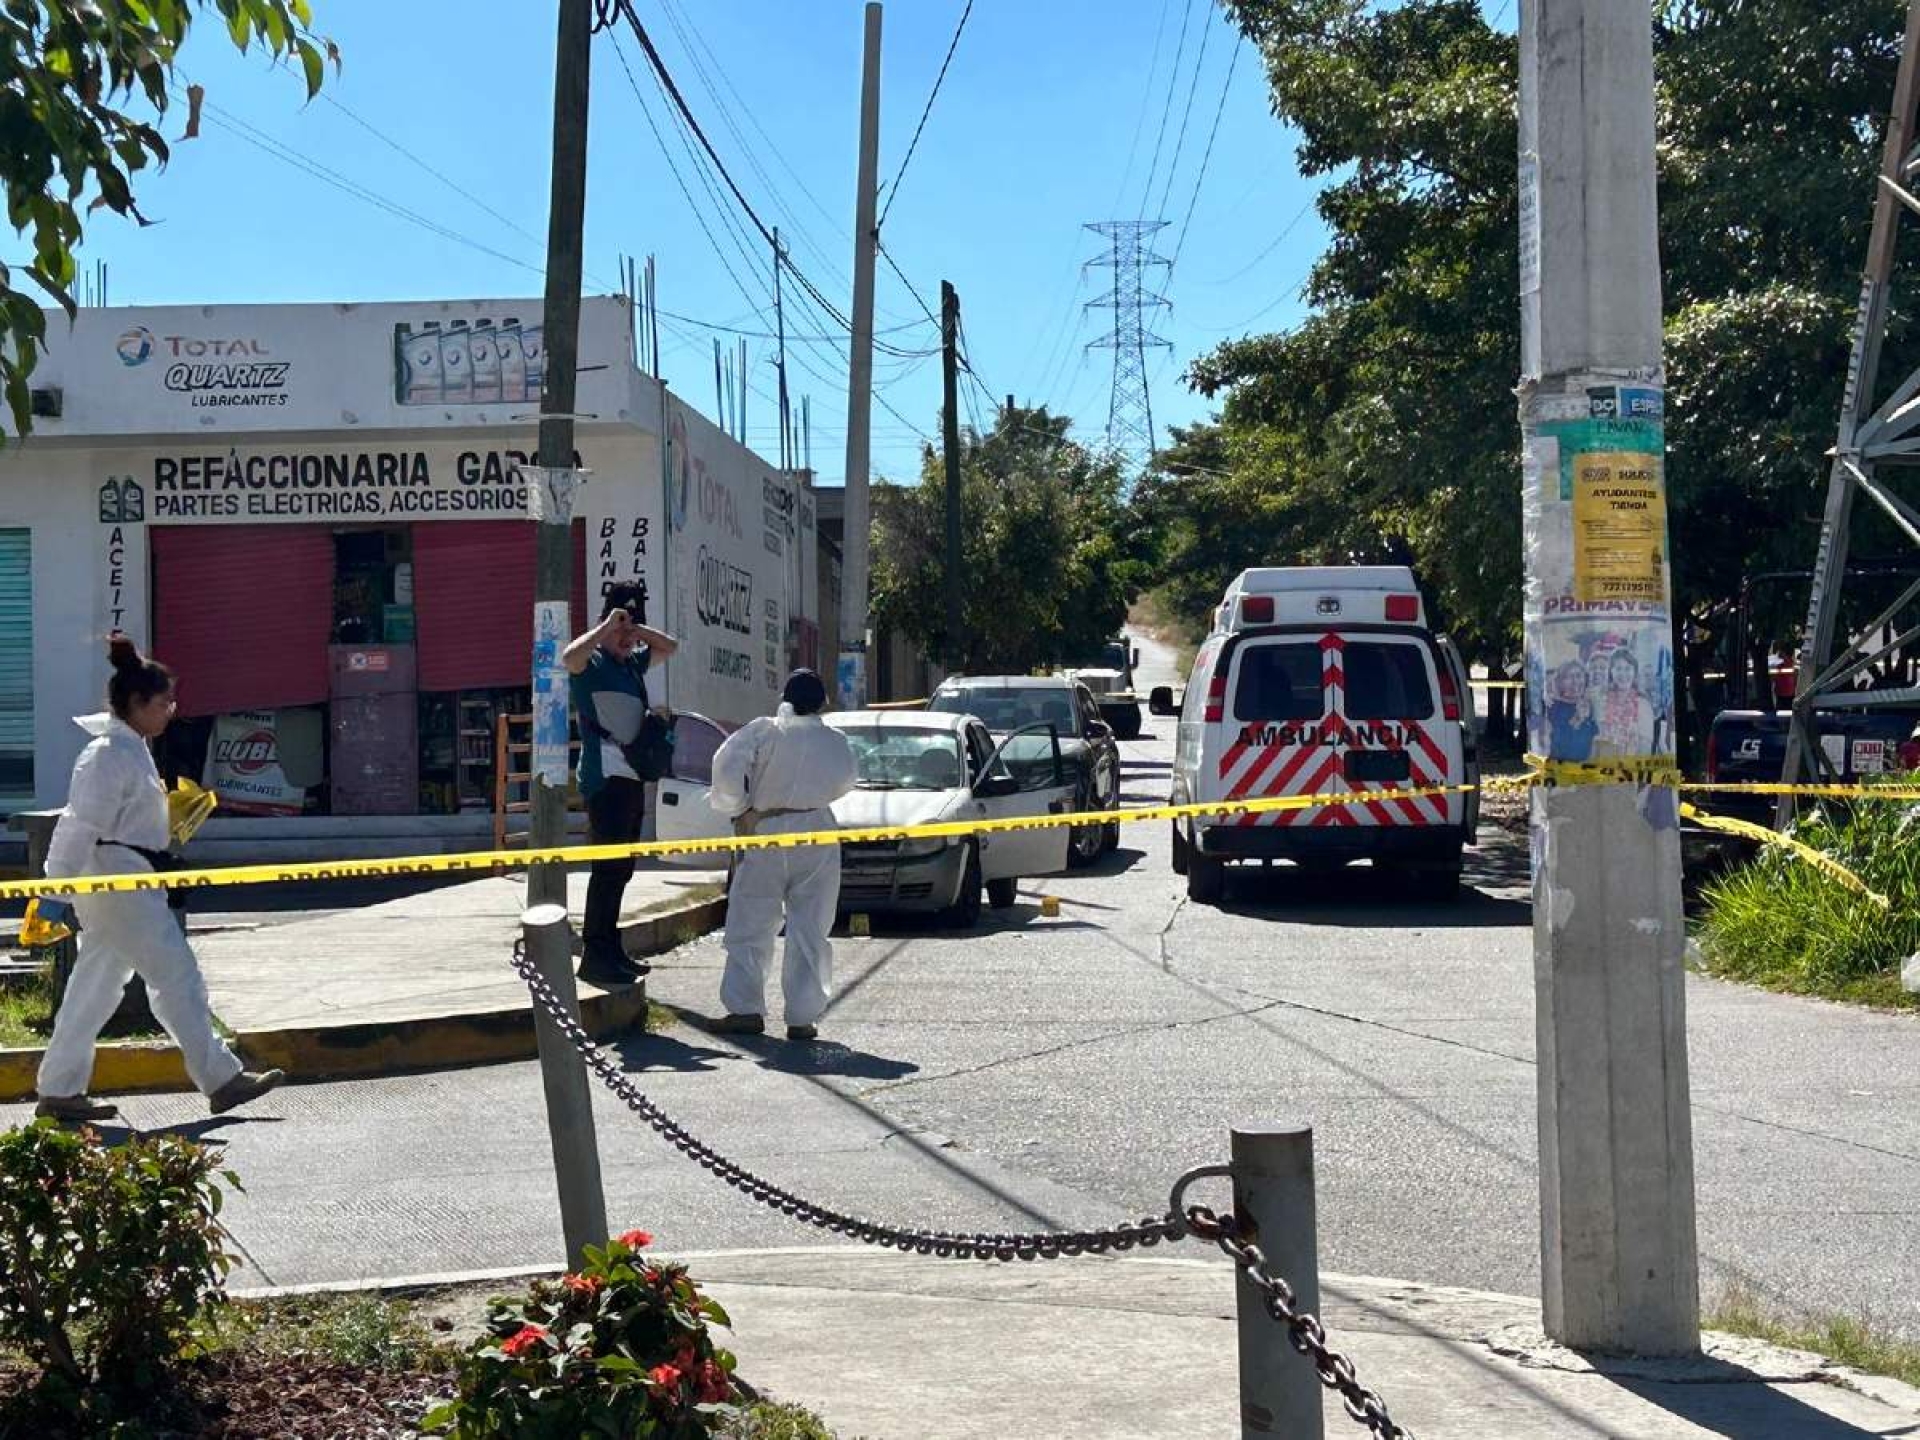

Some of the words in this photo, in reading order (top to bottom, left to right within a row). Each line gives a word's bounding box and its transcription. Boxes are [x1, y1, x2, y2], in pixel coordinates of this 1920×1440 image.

[165, 335, 270, 357] TOTAL
[165, 363, 291, 392] QUARTZ
[191, 394, 289, 407] LUBRICANTES
[154, 452, 431, 491] REFACCIONARIA
[154, 494, 240, 516] PARTES
[1236, 726, 1421, 747] AMBULANCIA
